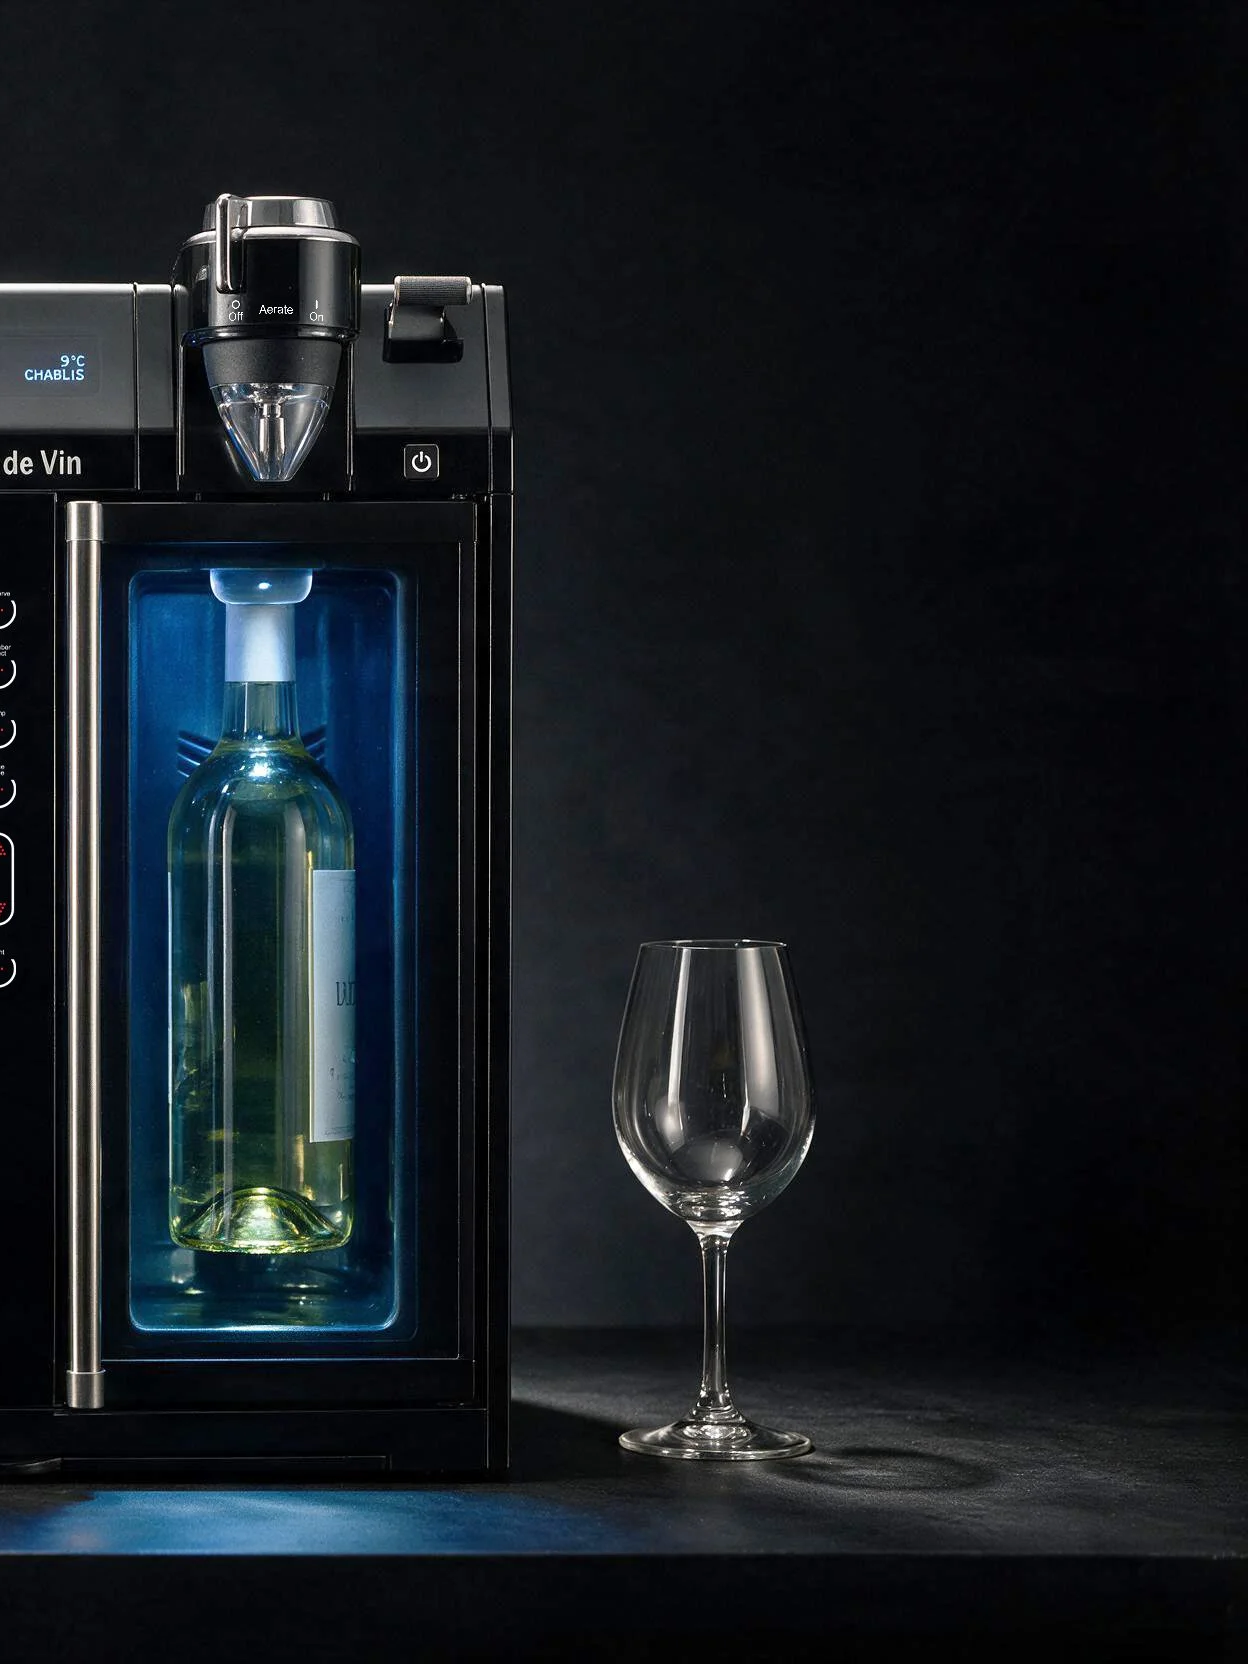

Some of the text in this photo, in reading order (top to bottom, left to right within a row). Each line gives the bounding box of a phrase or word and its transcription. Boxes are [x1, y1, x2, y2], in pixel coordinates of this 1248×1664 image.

[258, 304, 294, 315] Aerate
[228, 311, 244, 322] Off
[309, 311, 324, 322] On
[60, 355, 85, 368] 9°C
[24, 369, 85, 381] CHABLIS
[3, 449, 34, 475] de
[40, 449, 82, 475] Vin
